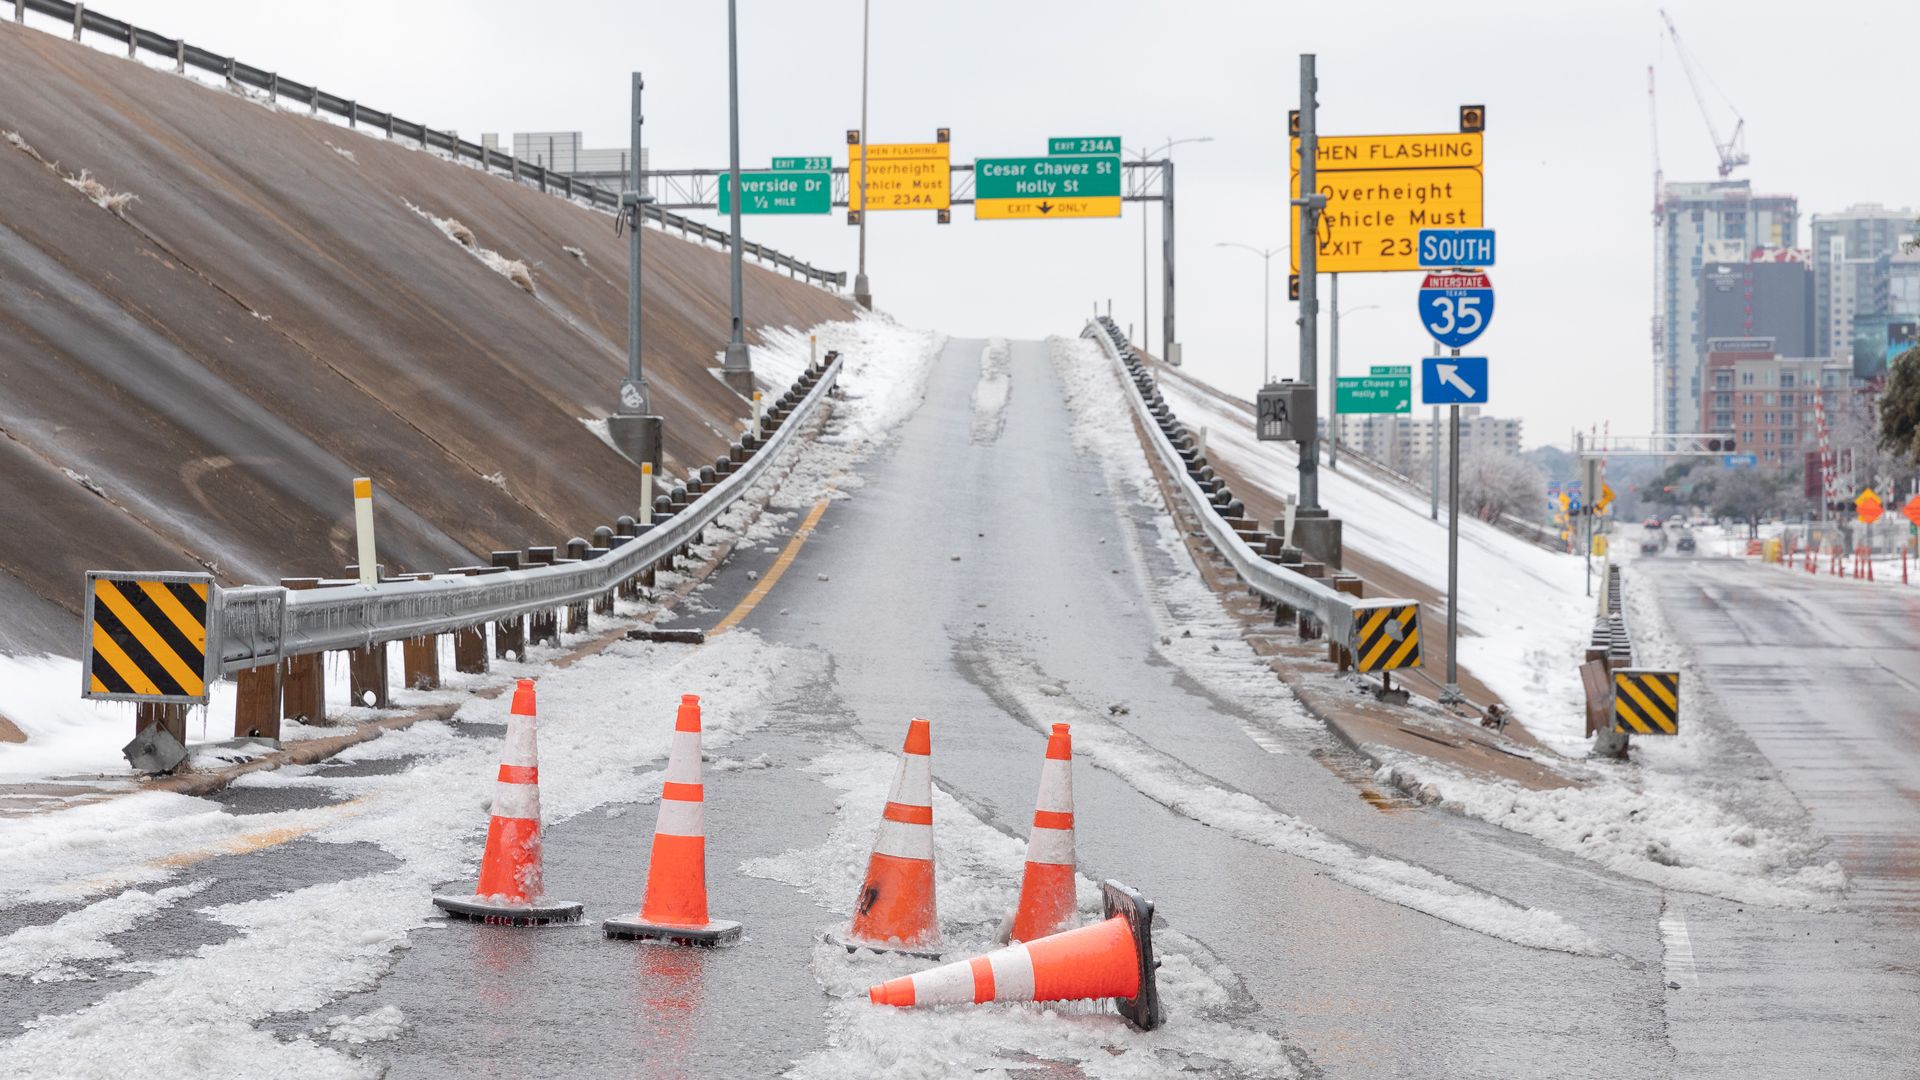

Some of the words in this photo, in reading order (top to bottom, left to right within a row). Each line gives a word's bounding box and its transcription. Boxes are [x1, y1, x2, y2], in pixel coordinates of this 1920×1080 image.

[1054, 142, 1075, 151] EXIT
[1080, 140, 1114, 152] 234A
[1316, 145, 1358, 160] HEN
[1370, 142, 1473, 159] FLASHING
[775, 160, 795, 168] EXIT
[804, 158, 828, 170] 233
[983, 164, 1026, 176] Cesar
[1034, 162, 1088, 176] Chavez
[1096, 162, 1112, 174] St
[728, 179, 798, 192] verside
[805, 179, 822, 192] Dr
[913, 180, 942, 188] Must
[1016, 180, 1056, 195] Holly
[1064, 180, 1079, 192] St
[894, 194, 932, 205] 234A
[1320, 183, 1452, 204] Overheight
[774, 198, 796, 206] MILE
[1008, 204, 1031, 213] EXIT
[1058, 204, 1088, 212] ONLY
[1326, 211, 1394, 227] ehicle
[1410, 208, 1466, 225] Must
[1380, 238, 1418, 256] 23
[1424, 235, 1490, 260] SOUTH
[1430, 277, 1483, 288] INTERSTATE
[1430, 296, 1482, 334] 35
